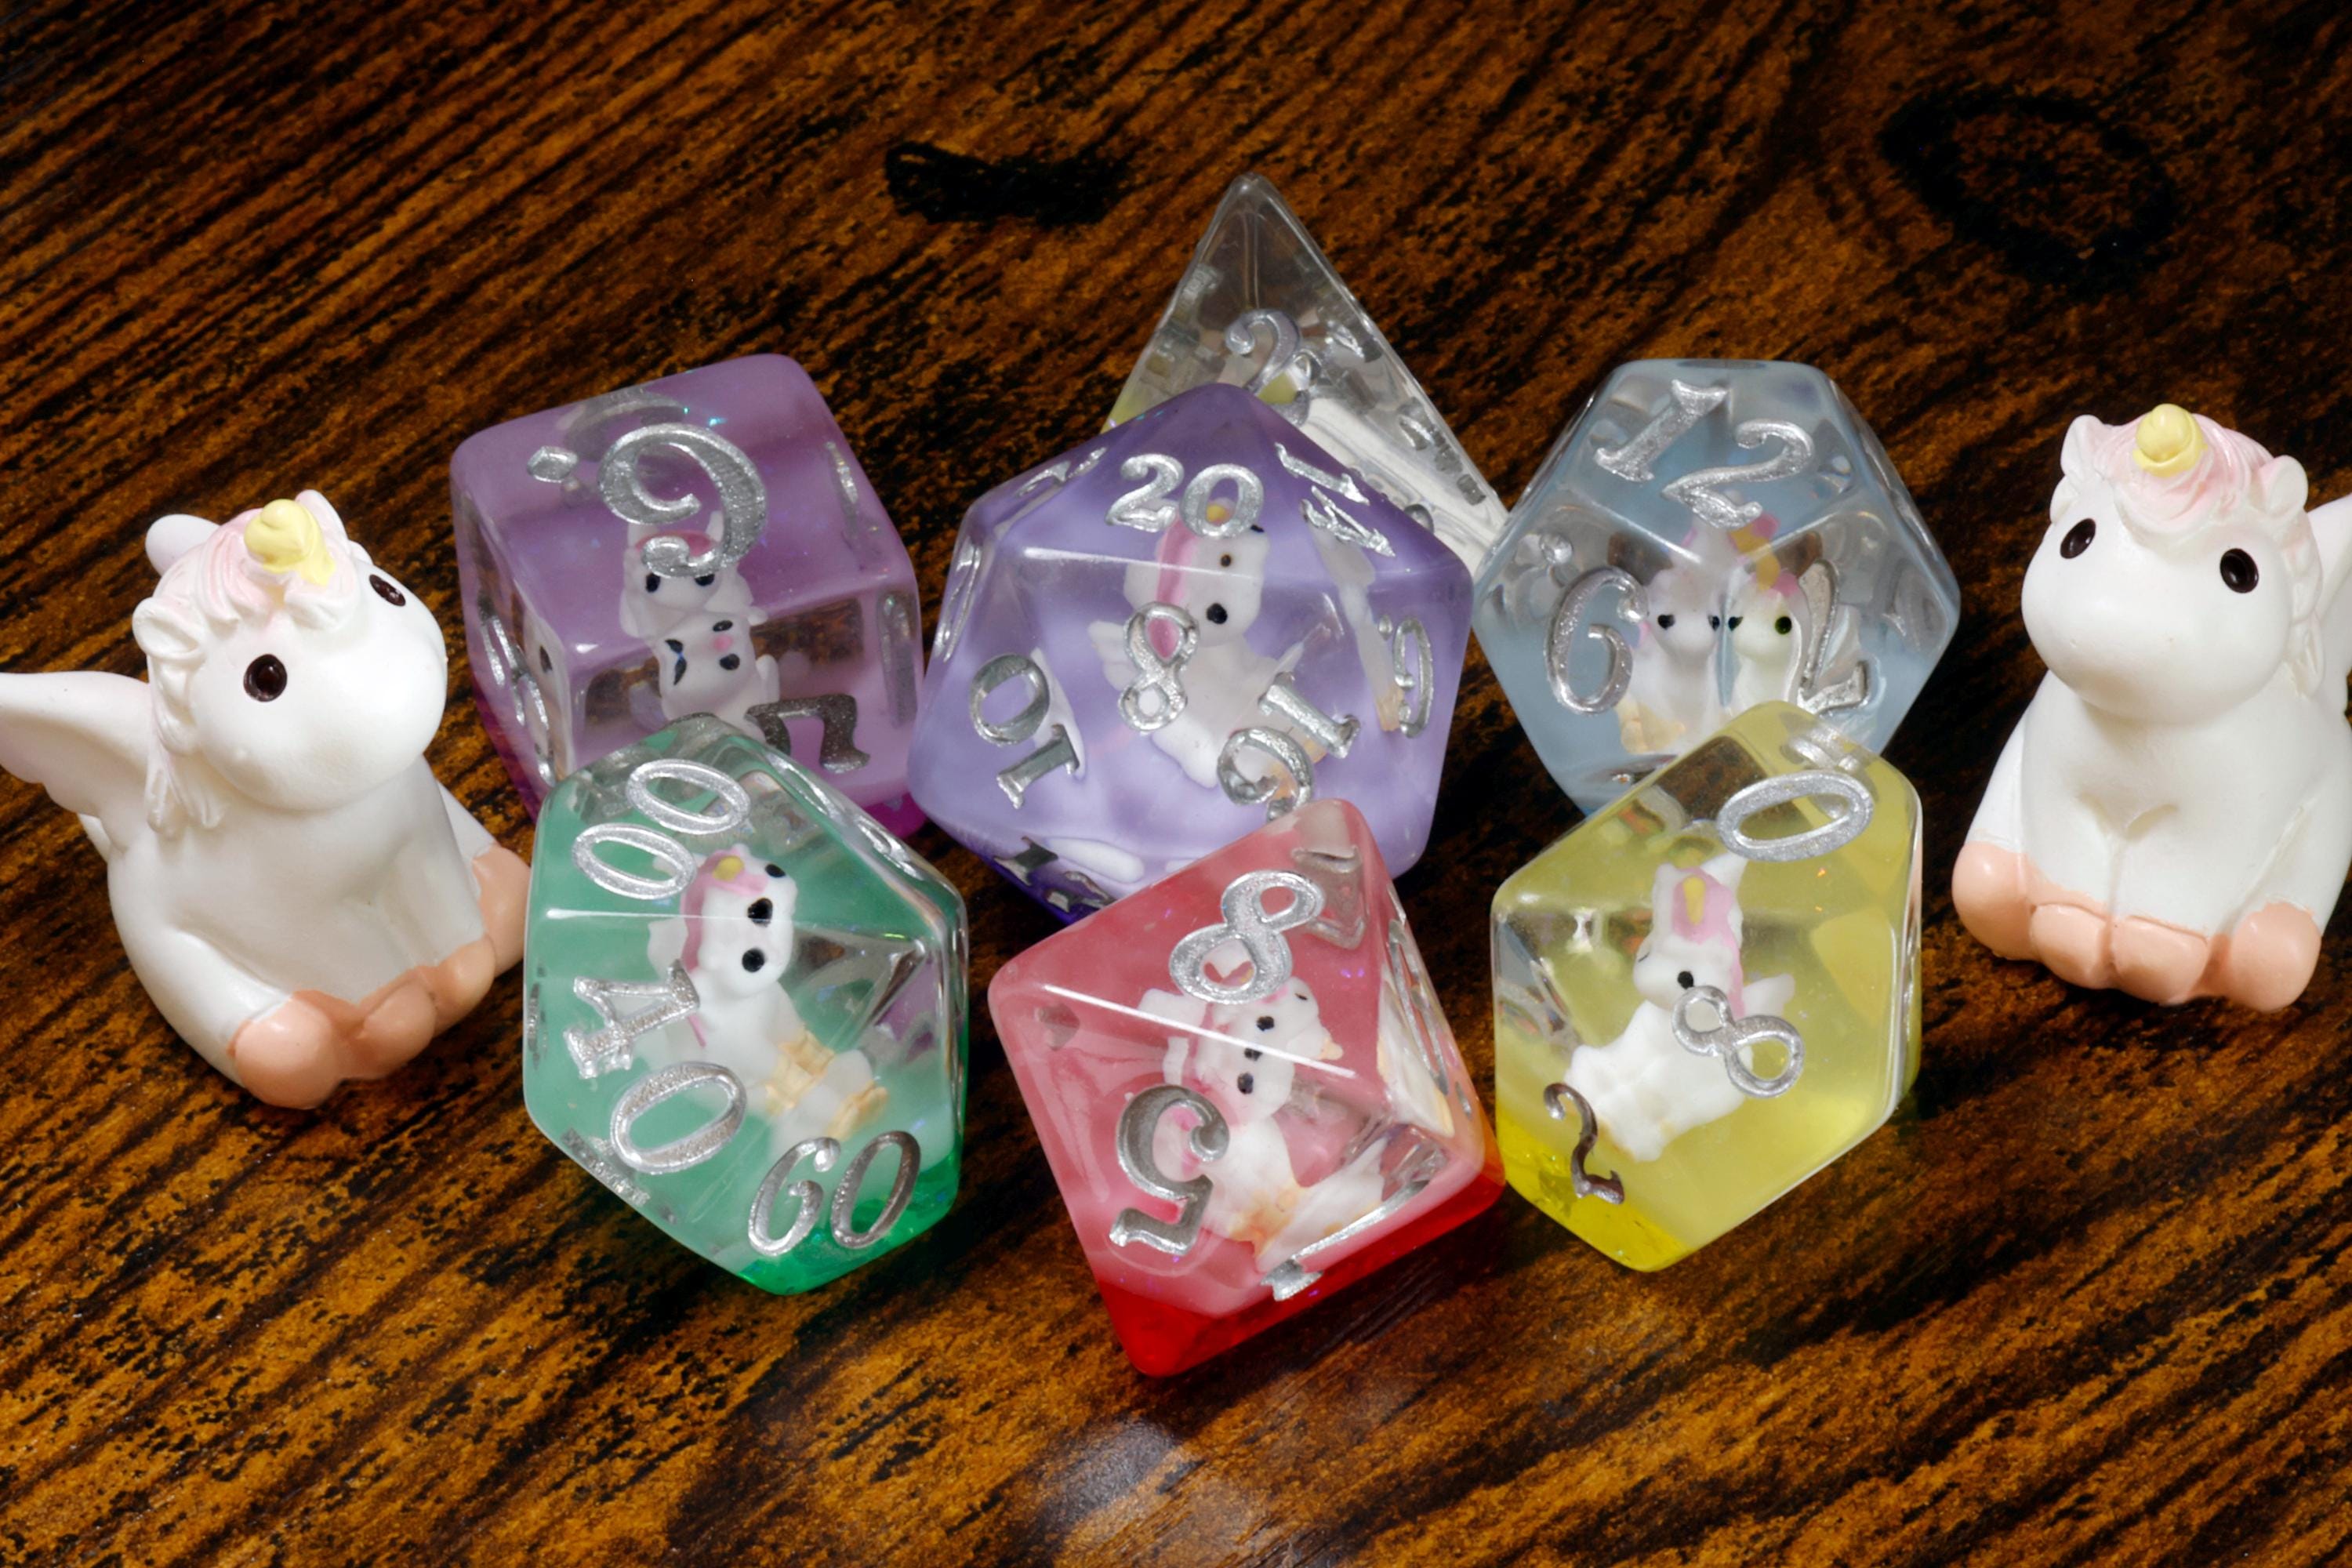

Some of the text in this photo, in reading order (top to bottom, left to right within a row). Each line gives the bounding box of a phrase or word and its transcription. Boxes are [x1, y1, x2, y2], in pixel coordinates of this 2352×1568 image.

[1104, 453, 1265, 539] 20
[1595, 379, 1814, 529] 12
[1117, 601, 1200, 733] 8
[571, 758, 751, 900] 00
[1717, 770, 1875, 862] 0
[1171, 869, 1326, 1004] 8
[562, 959, 747, 1175] 40
[1672, 985, 1806, 1098] 8
[746, 1130, 922, 1257] 60
[1109, 1084, 1231, 1256] 5
[1542, 1083, 1626, 1205] 2
